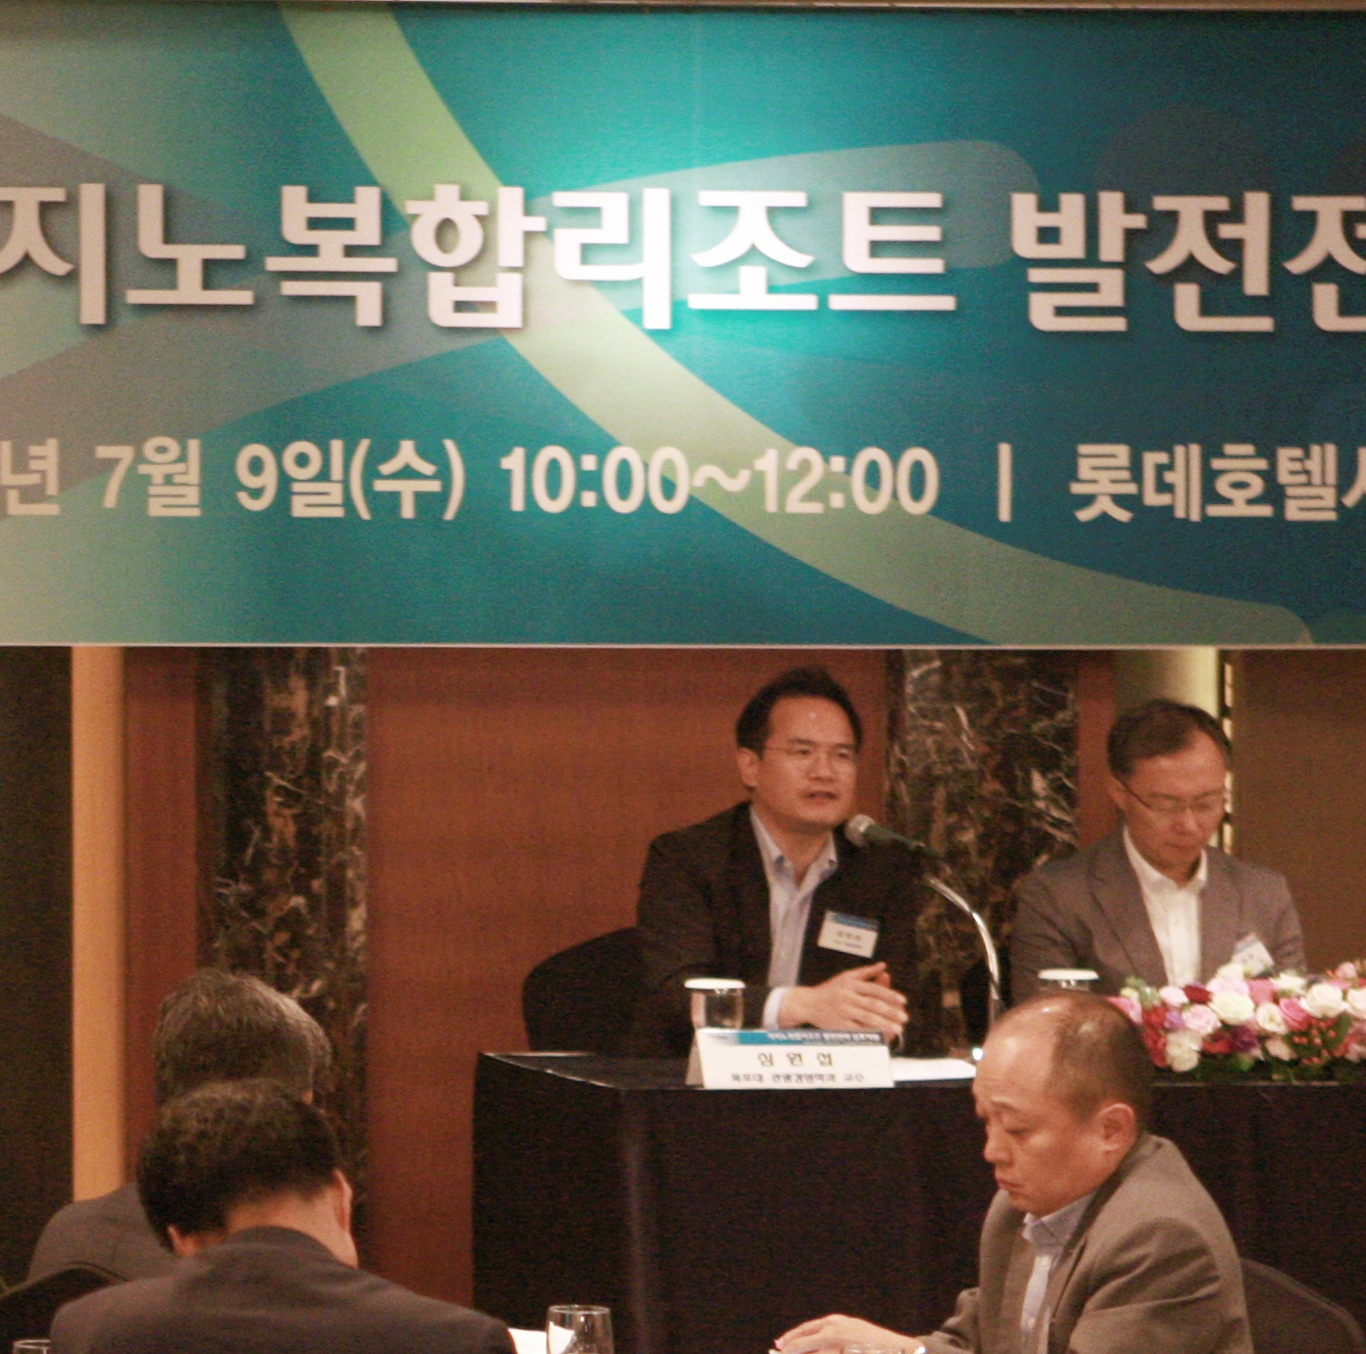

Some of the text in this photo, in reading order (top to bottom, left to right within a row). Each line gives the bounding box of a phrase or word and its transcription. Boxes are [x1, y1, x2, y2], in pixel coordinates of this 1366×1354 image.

[95, 437, 201, 517] 7월
[236, 437, 465, 520] 9일(수)
[500, 445, 938, 515] 10:00~12:00
